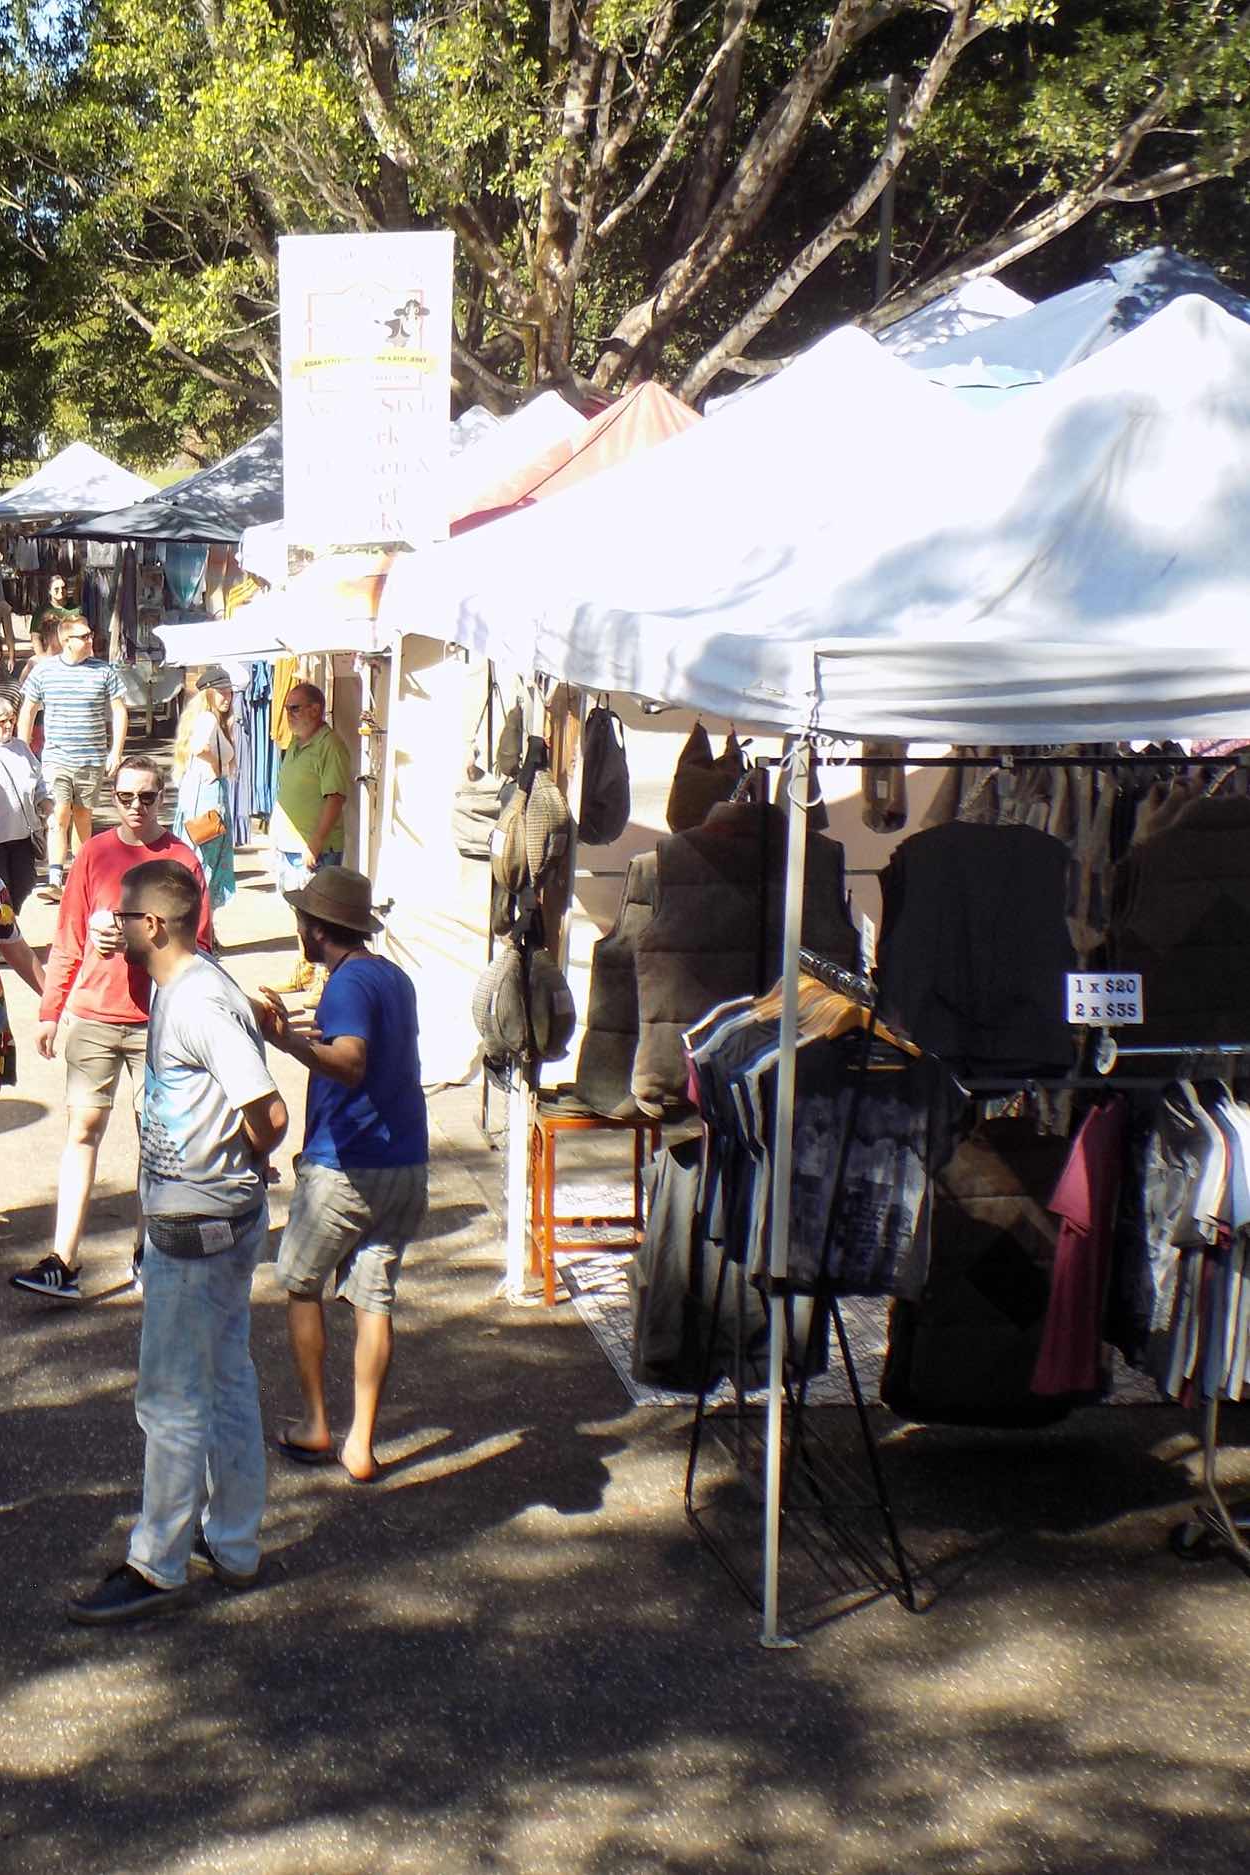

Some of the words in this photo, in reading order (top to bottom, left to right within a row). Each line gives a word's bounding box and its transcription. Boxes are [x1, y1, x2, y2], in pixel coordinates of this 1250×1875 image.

[1075, 979, 1084, 993] 1
[1089, 984, 1101, 993] x
[1105, 979, 1137, 994] $20
[1075, 1003, 1085, 1017] 2
[1090, 1008, 1102, 1017] x
